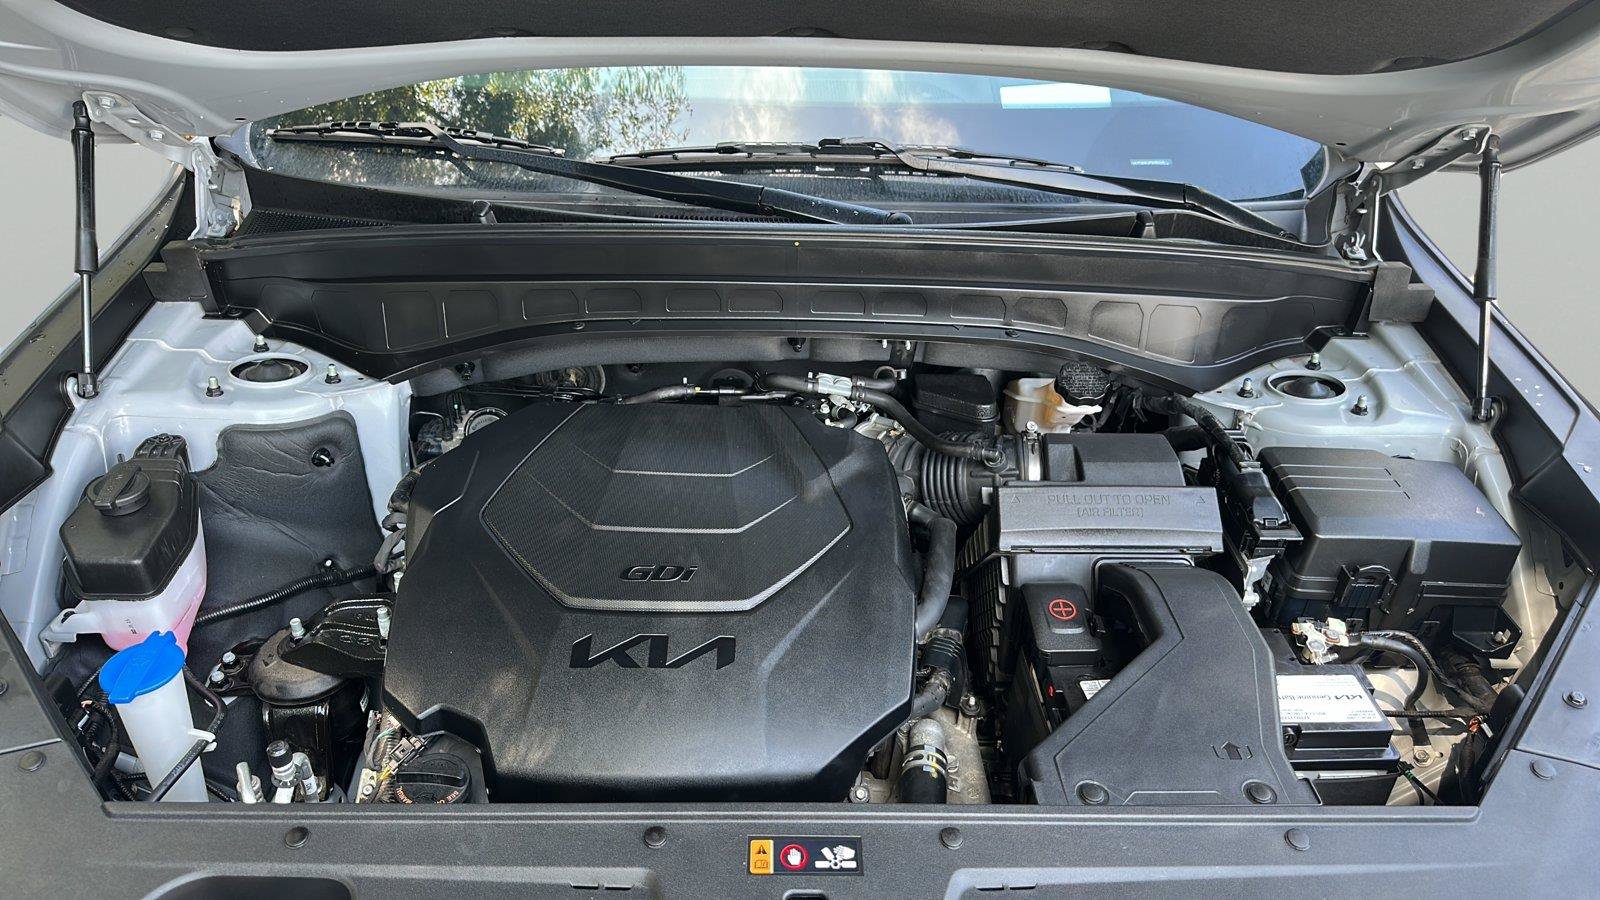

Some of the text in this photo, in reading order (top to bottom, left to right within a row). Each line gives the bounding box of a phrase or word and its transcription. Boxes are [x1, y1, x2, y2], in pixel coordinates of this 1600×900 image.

[1047, 494, 1171, 505] PULL OUT TO OPEN
[569, 634, 736, 670] KIA
